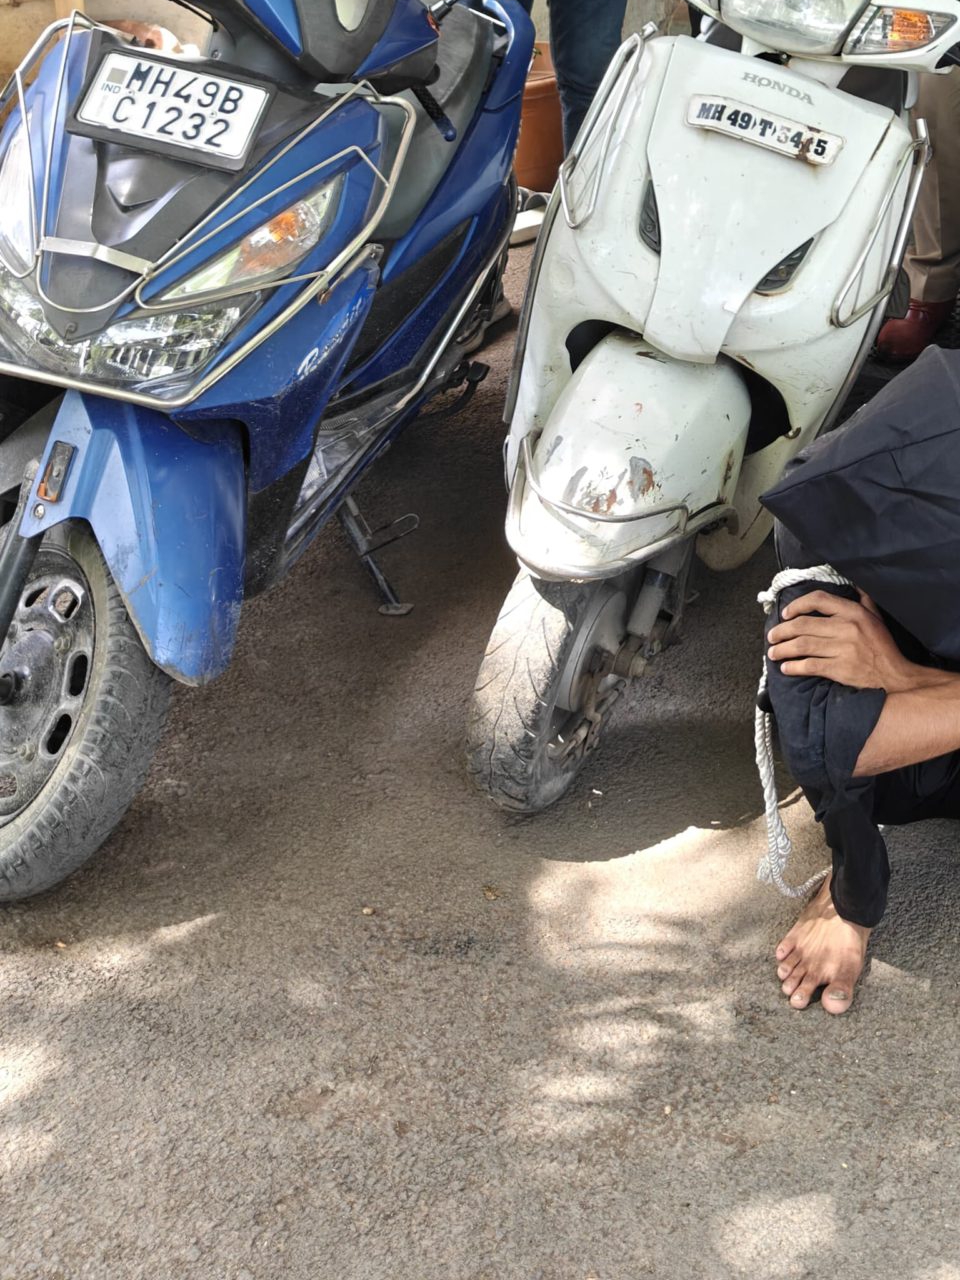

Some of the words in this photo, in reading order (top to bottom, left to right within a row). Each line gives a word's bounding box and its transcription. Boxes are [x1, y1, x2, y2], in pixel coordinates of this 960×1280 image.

[101, 82, 122, 95] IND
[125, 61, 243, 115] MH49B
[741, 72, 815, 106] HONDA
[112, 96, 230, 148] C1232
